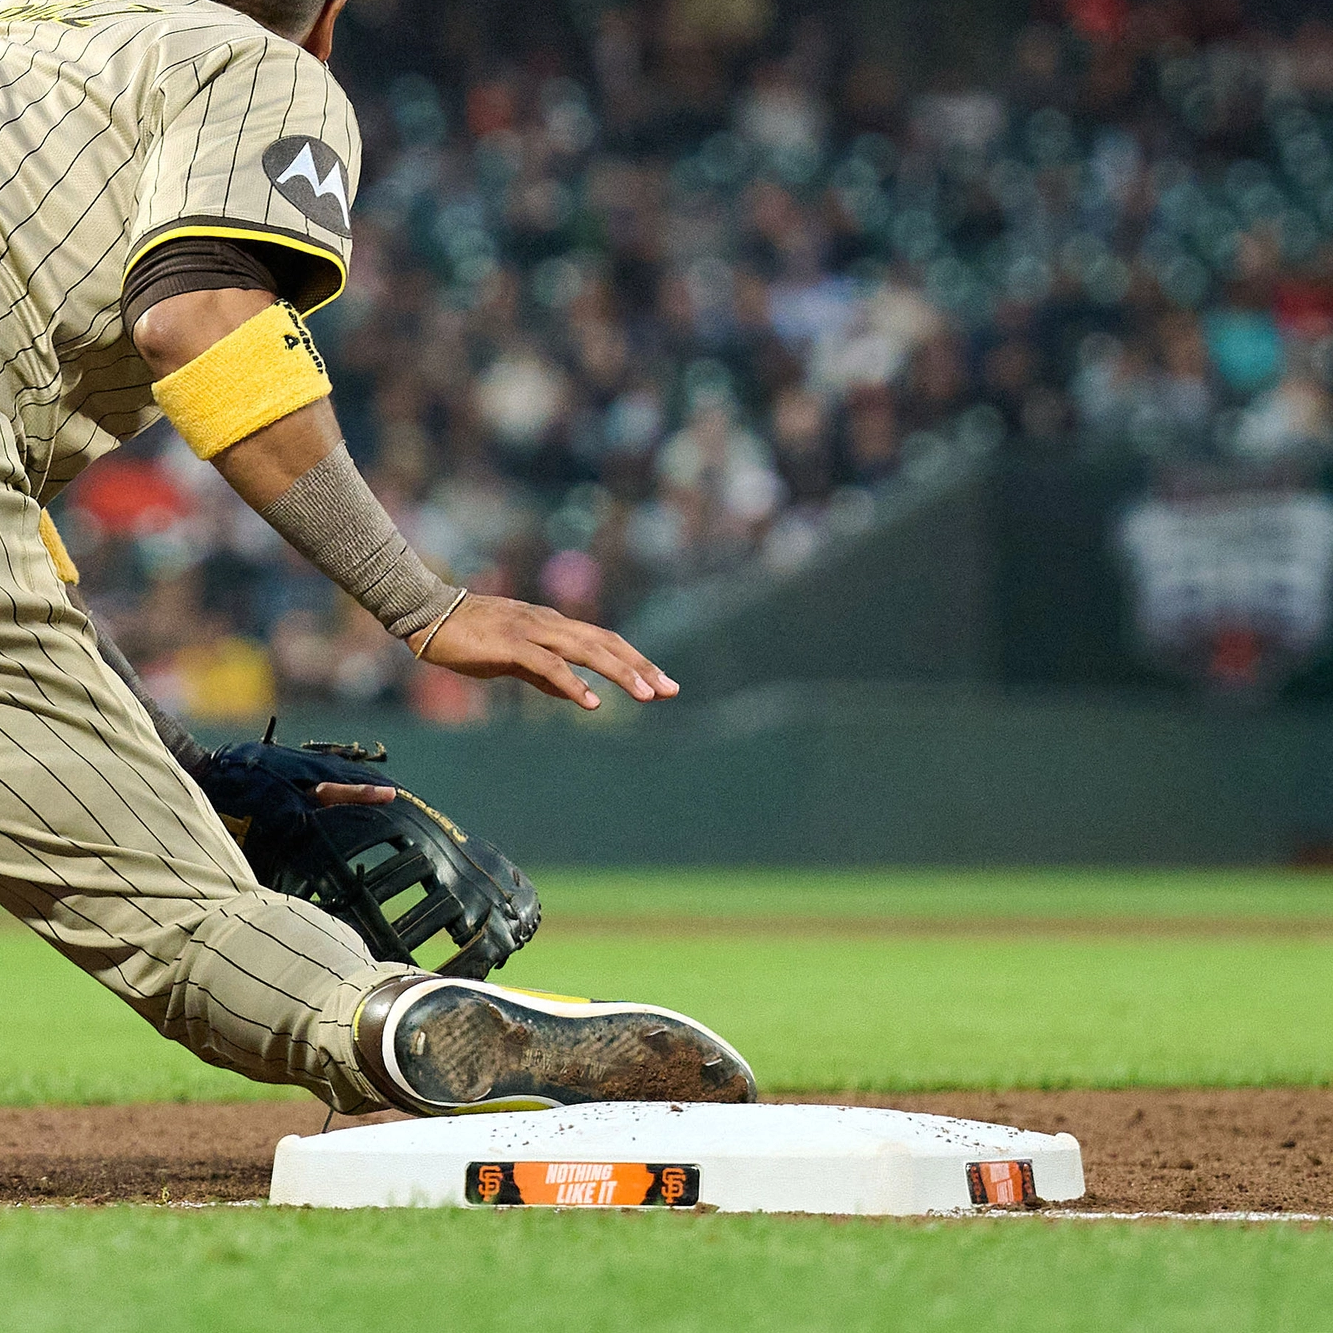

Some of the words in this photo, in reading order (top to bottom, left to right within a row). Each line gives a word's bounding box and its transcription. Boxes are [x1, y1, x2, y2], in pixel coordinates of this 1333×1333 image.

[545, 1163, 614, 1184] NOTHING
[556, 1182, 595, 1204] LIKE
[597, 1180, 619, 1204] IT
